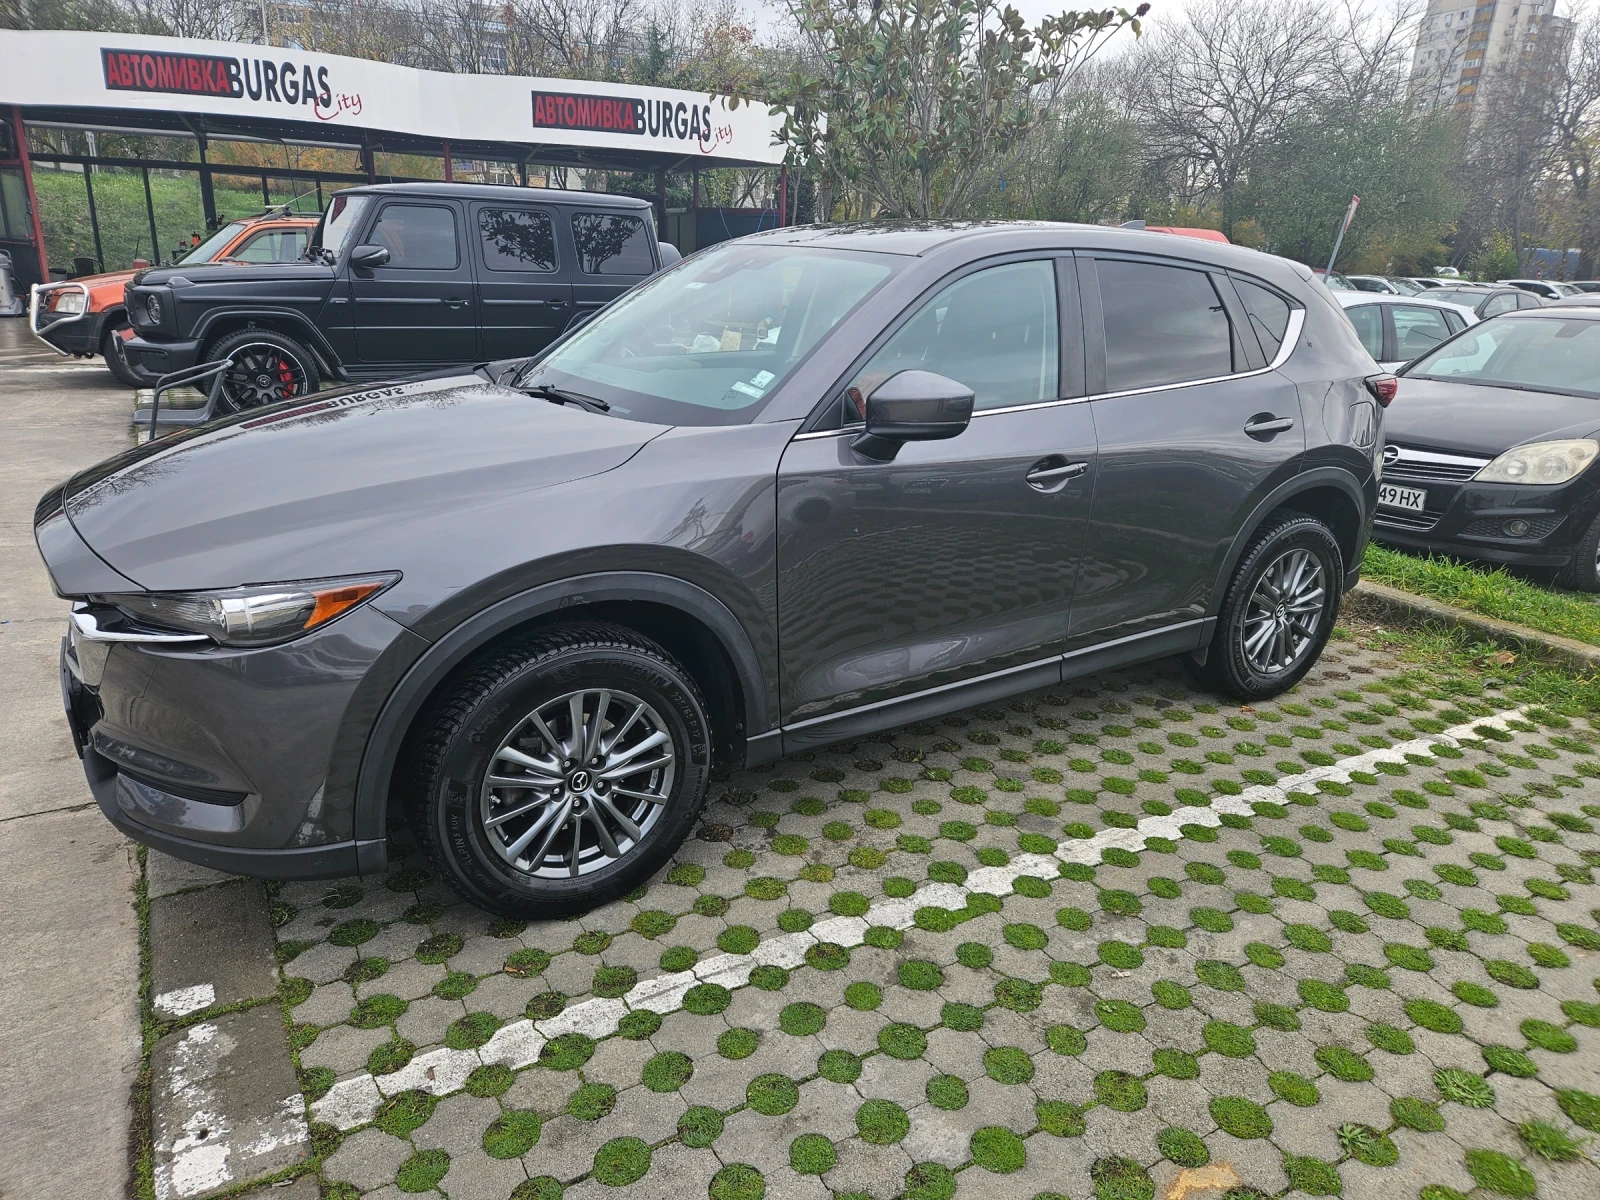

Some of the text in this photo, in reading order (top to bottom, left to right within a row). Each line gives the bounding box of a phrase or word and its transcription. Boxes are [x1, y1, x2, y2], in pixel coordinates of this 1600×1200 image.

[107, 53, 230, 92] АВТОМИВКА
[230, 57, 362, 120] BURGAS City
[535, 96, 634, 129] АВТОМИВКА
[635, 99, 733, 154] BURGAS City
